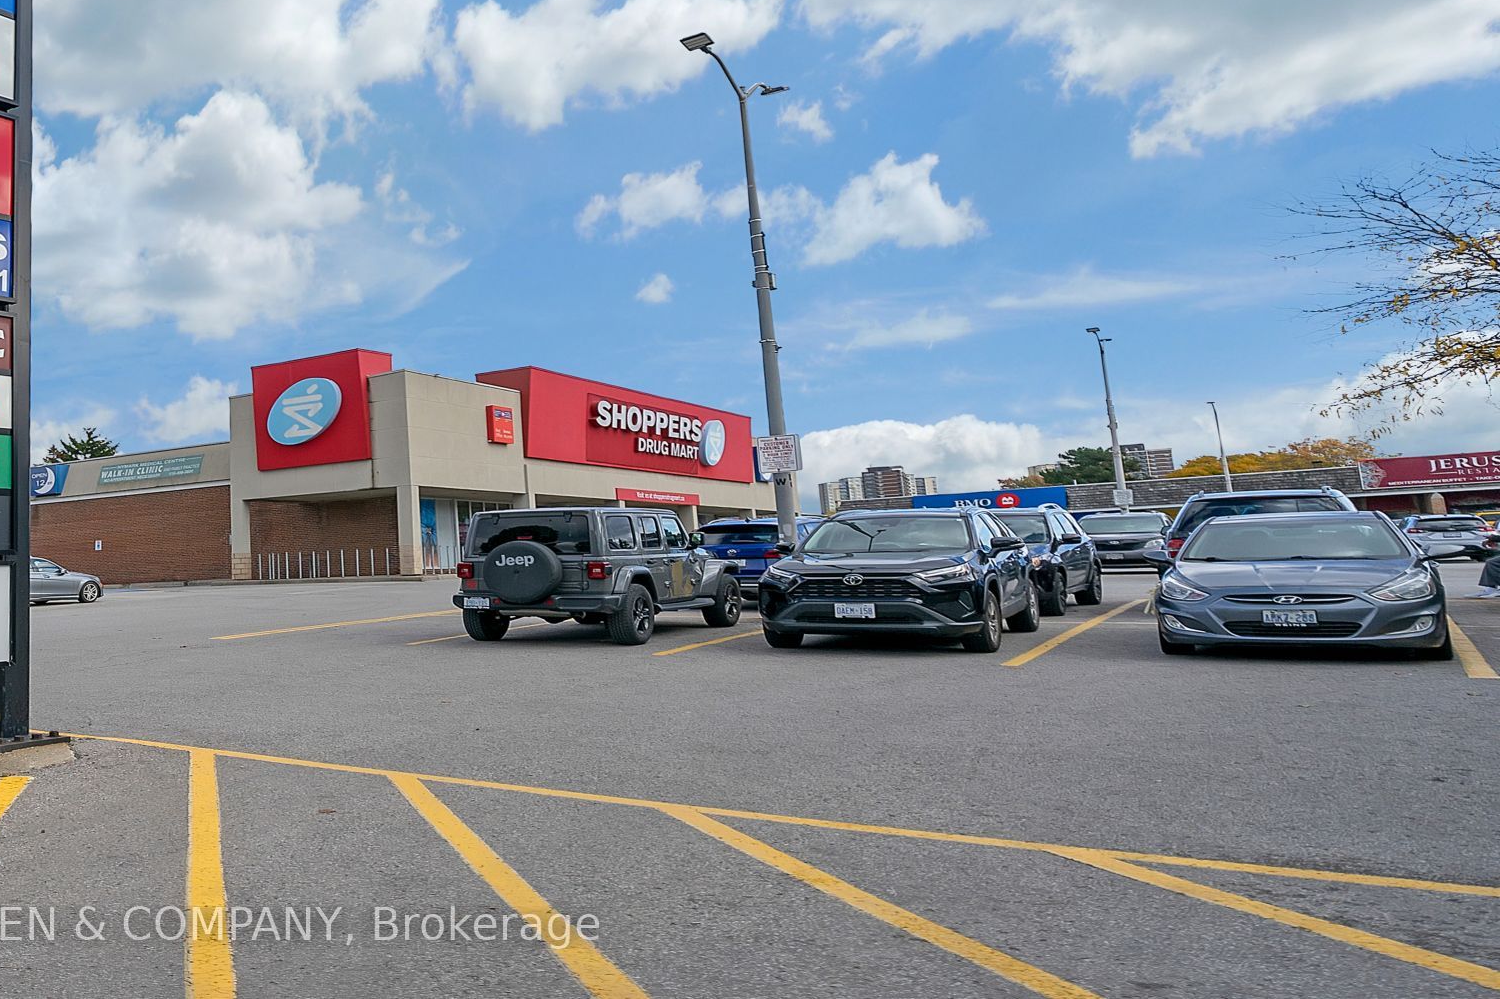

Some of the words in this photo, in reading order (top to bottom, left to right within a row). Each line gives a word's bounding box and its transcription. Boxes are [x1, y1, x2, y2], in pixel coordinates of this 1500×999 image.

[596, 400, 702, 442] SHOPPERS
[638, 437, 669, 455] DRUG
[671, 442, 699, 460] MART
[1429, 455, 1500, 472] JERUS
[101, 468, 134, 478] WALK-IN
[136, 466, 163, 475] CLINIC
[954, 498, 992, 508] BMO
[495, 554, 535, 568] Jeep
